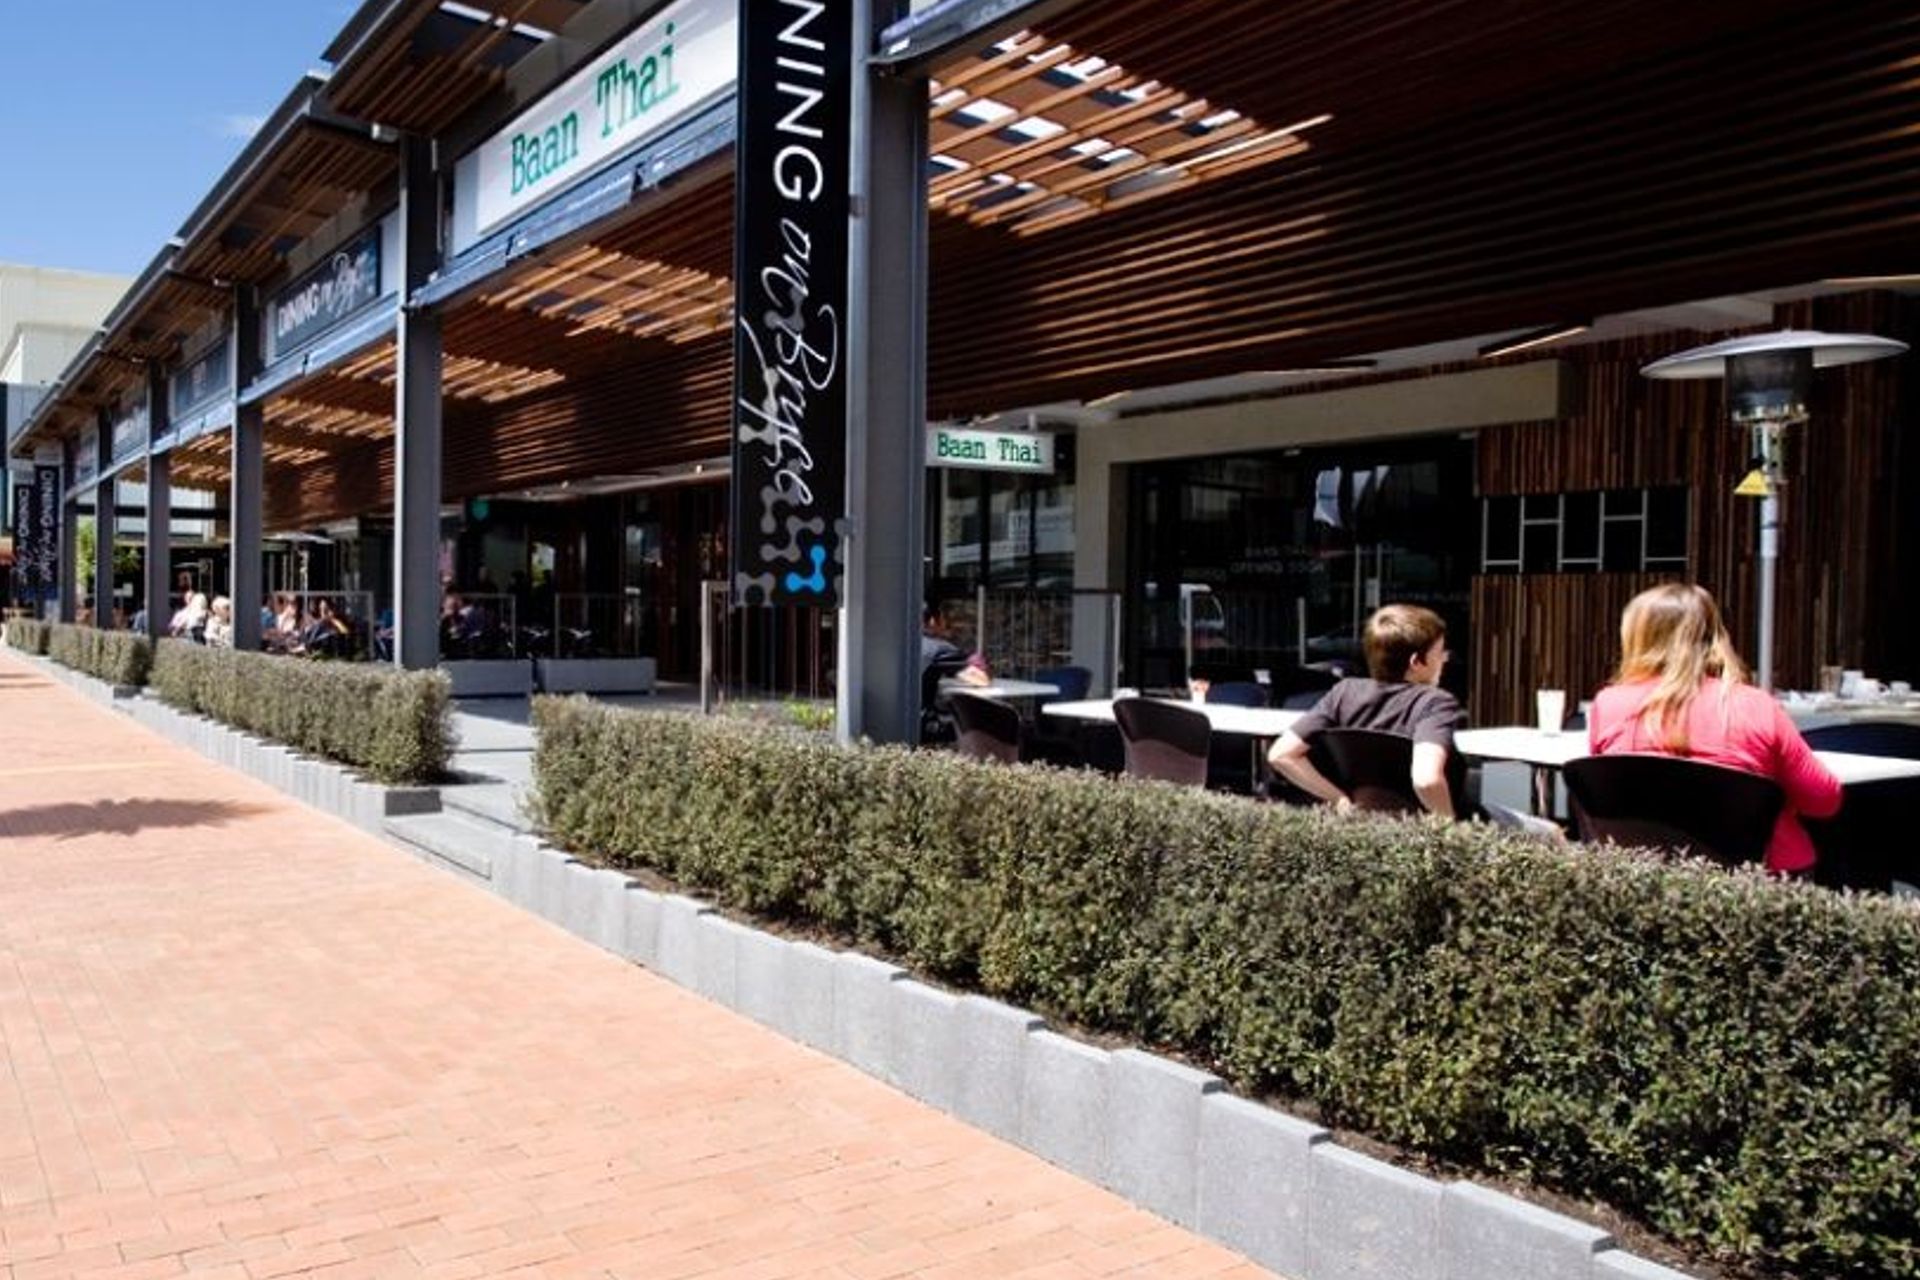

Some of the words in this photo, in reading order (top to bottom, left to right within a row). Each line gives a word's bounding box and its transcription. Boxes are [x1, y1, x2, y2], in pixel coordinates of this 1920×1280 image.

[511, 111, 578, 196] Baan
[597, 22, 680, 138] Thai
[761, 217, 812, 309] on
[278, 283, 320, 337] DINING
[937, 432, 986, 460] Baan
[997, 437, 1043, 464] Thai
[39, 469, 55, 528] DINING
